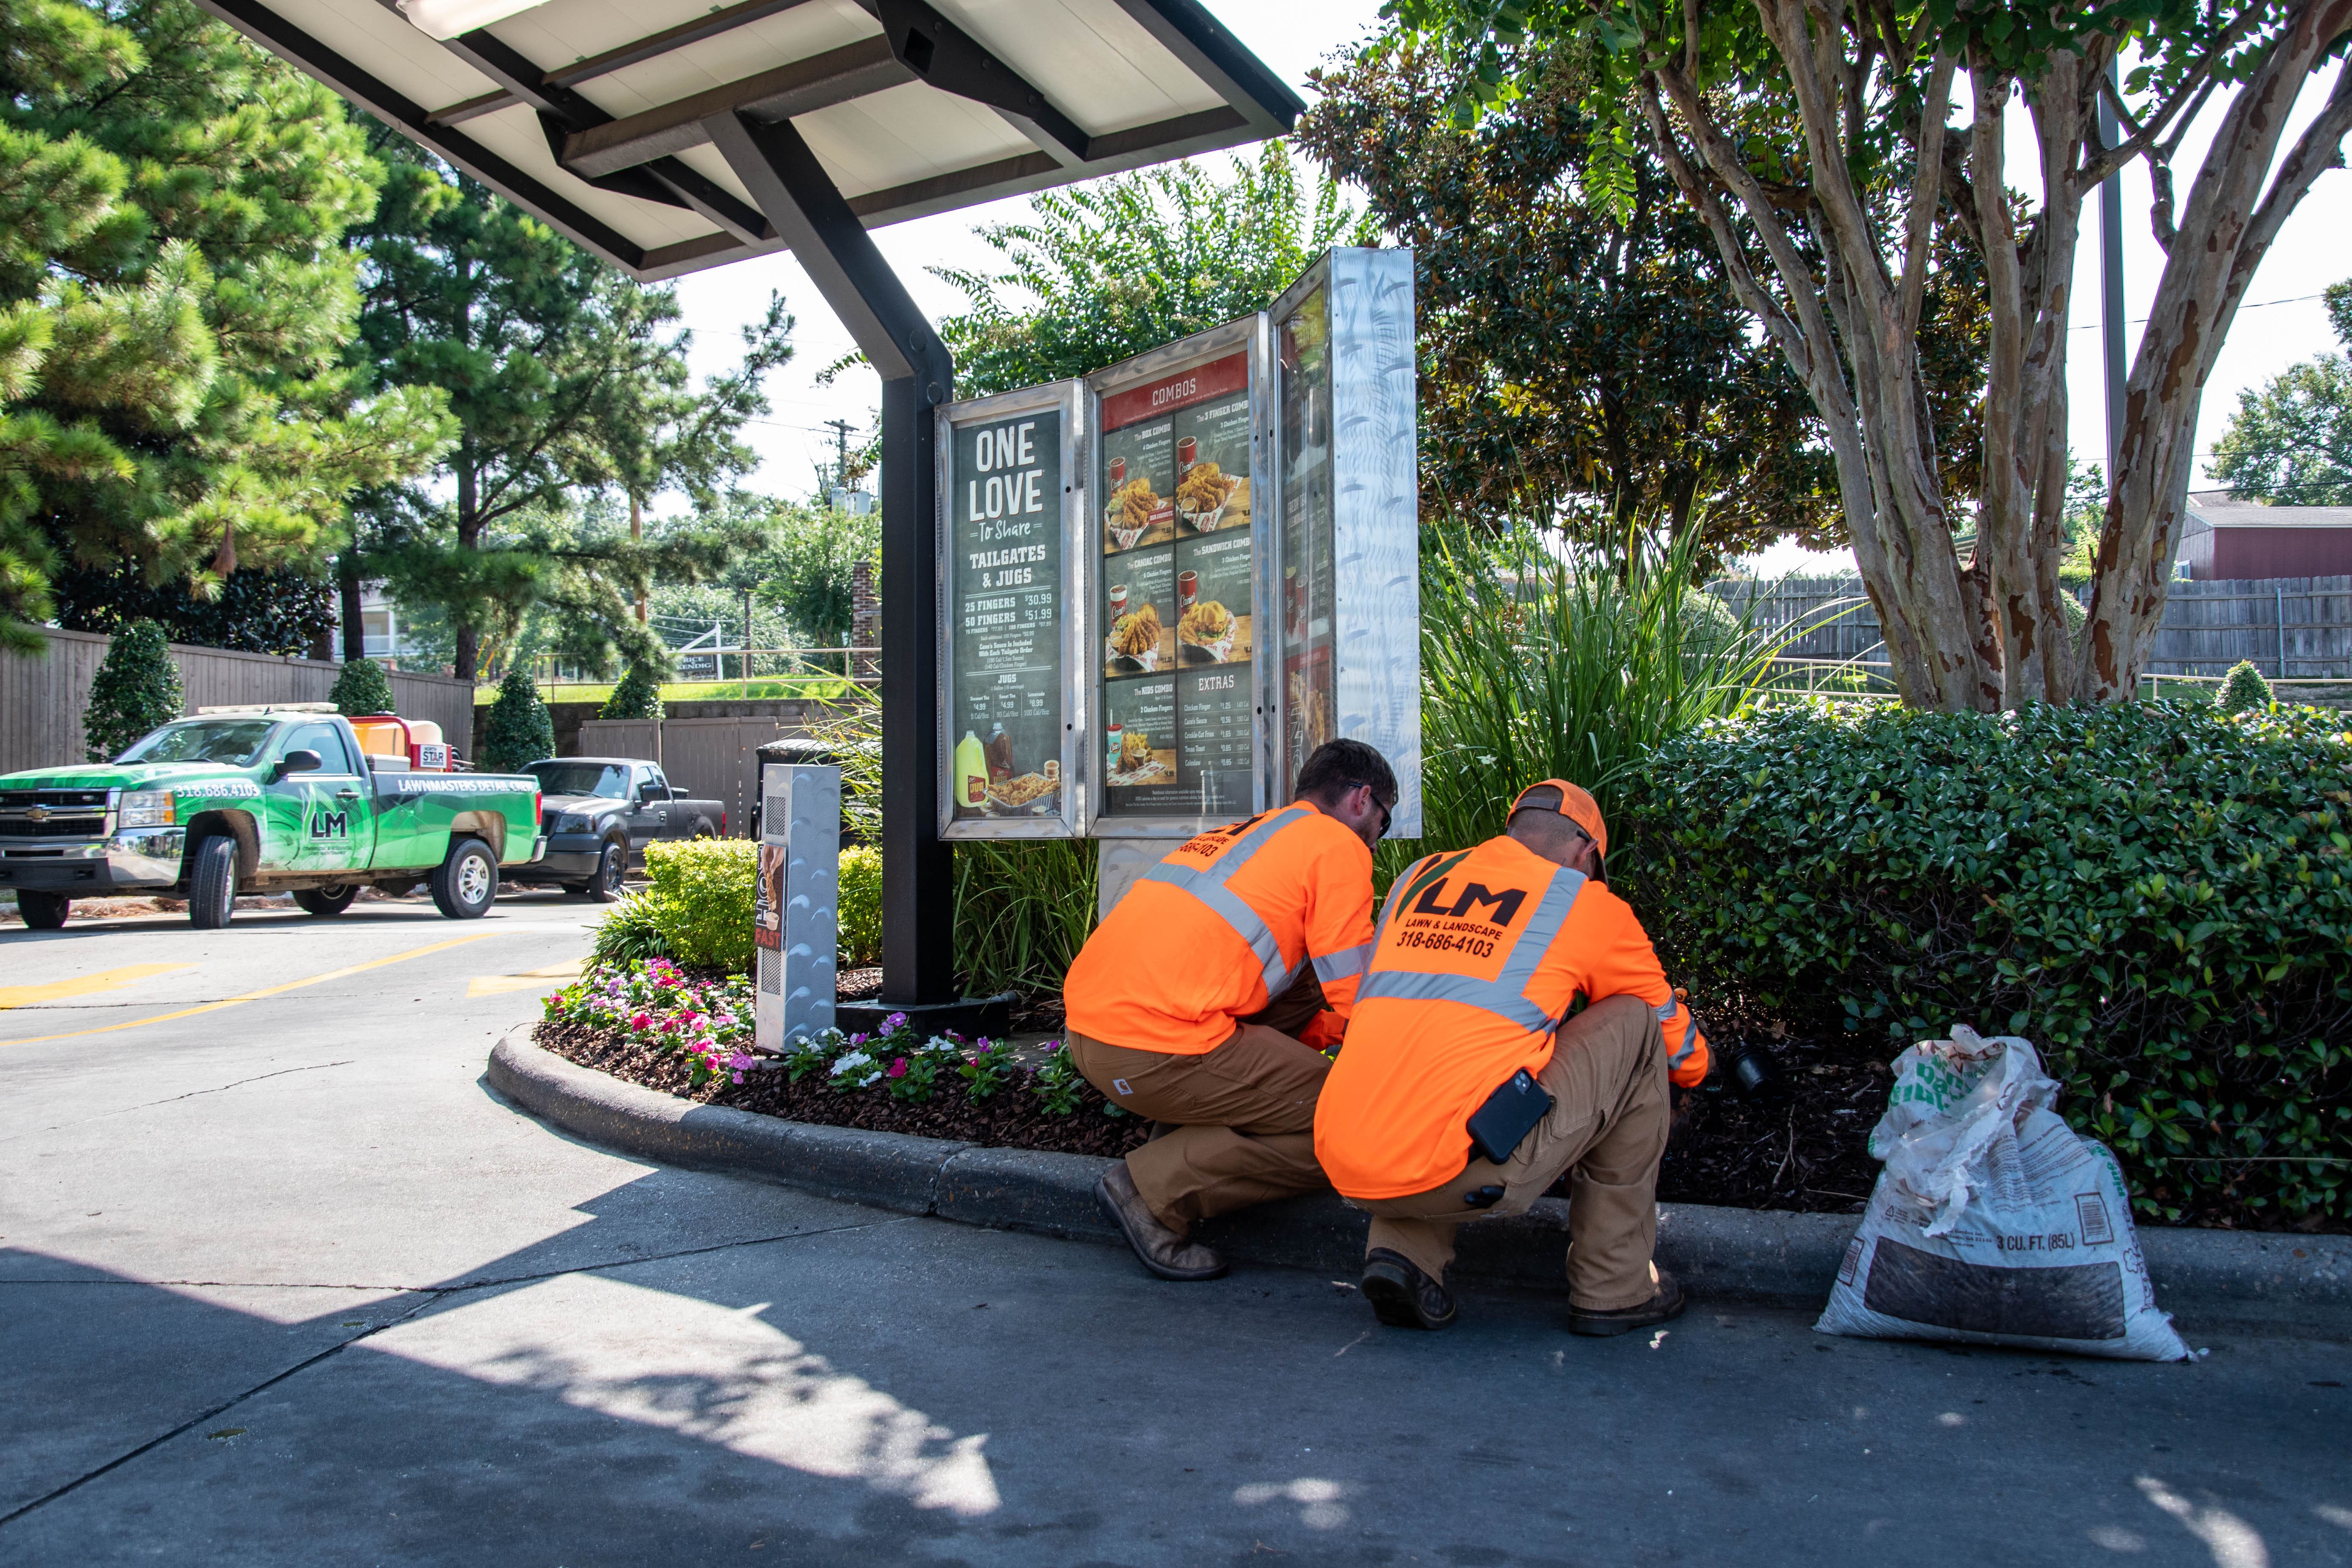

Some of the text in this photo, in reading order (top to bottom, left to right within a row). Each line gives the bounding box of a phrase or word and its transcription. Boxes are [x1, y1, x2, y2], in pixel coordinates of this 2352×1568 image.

[1152, 378, 1196, 406] COMBOS
[1209, 405, 1230, 419] FINGER
[1231, 400, 1249, 412] COMB
[1142, 429, 1152, 439] BOX
[1153, 423, 1171, 436] COMBO
[977, 422, 1035, 472] ONE
[970, 469, 1043, 522] LOVE
[979, 520, 1031, 542] To Share
[1202, 541, 1232, 555] SANDWICH
[1233, 537, 1251, 548] COMB
[970, 544, 1045, 569] TAILGATES
[1135, 557, 1153, 568] CANIAC
[1154, 553, 1171, 564] COMBO
[983, 567, 1032, 588] & JUGS
[965, 597, 1015, 612] 25 FINGERS
[1025, 593, 1051, 605] $30.99
[965, 612, 1015, 627] 50 FINGERS
[1025, 608, 1051, 620] $51.99
[998, 674, 1016, 683] JUGS
[1198, 675, 1234, 691] EXTRAS
[1142, 686, 1154, 695] KIDS
[1155, 684, 1173, 694] COMBO
[423, 751, 444, 762] STAR
[174, 783, 261, 798] 318.686.4103
[398, 780, 534, 792] LAWNMASTERS DETAIL CREW
[312, 812, 346, 837] LM
[1413, 877, 1528, 928] LM
[755, 928, 781, 948] FAST
[1405, 919, 1432, 928] LAWN
[1443, 922, 1503, 940] LANDSCAPE
[1397, 931, 1494, 958] 318-686-4103
[1997, 1232, 2074, 1251] 3 CU. FT. (85L)
